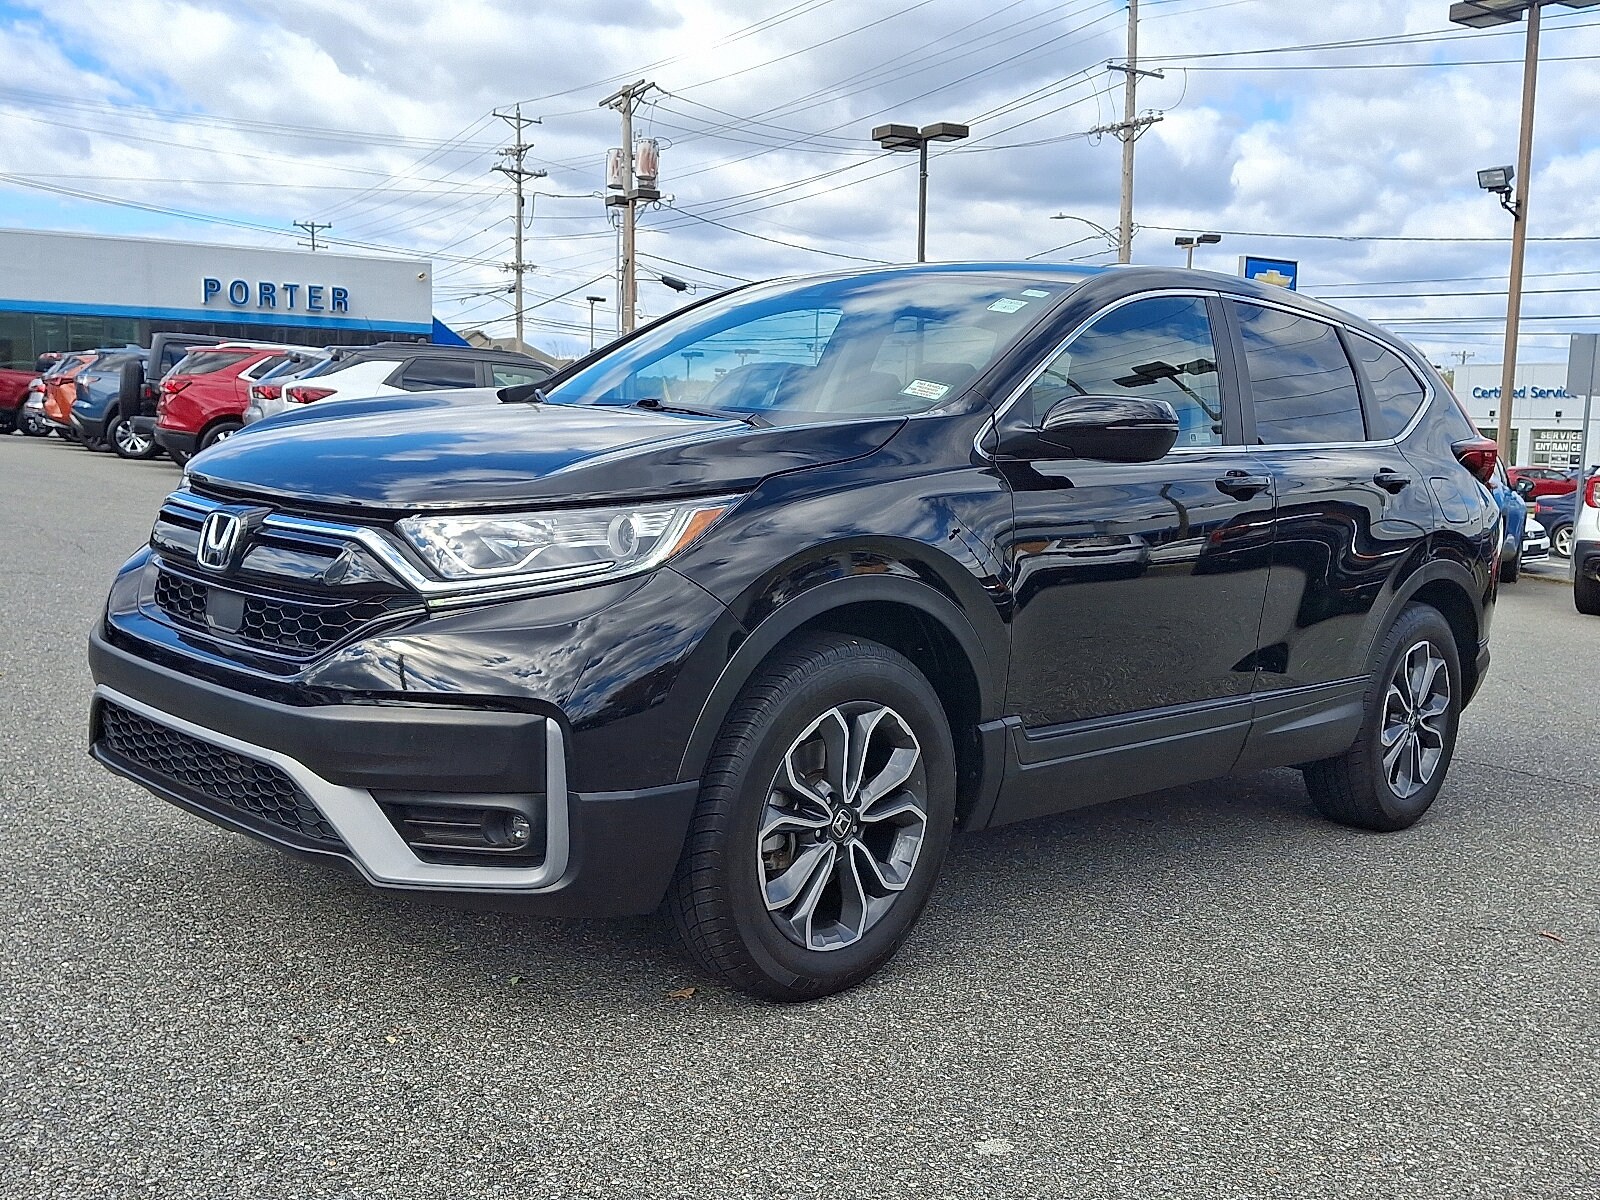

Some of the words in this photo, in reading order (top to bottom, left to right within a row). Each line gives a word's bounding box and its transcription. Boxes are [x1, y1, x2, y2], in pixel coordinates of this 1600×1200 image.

[201, 276, 350, 313] PORTER
[1472, 386, 1526, 399] Certied
[1531, 386, 1578, 399] Servic
[1540, 431, 1583, 440] SERVICE
[1535, 442, 1582, 452] ENTRANCE
